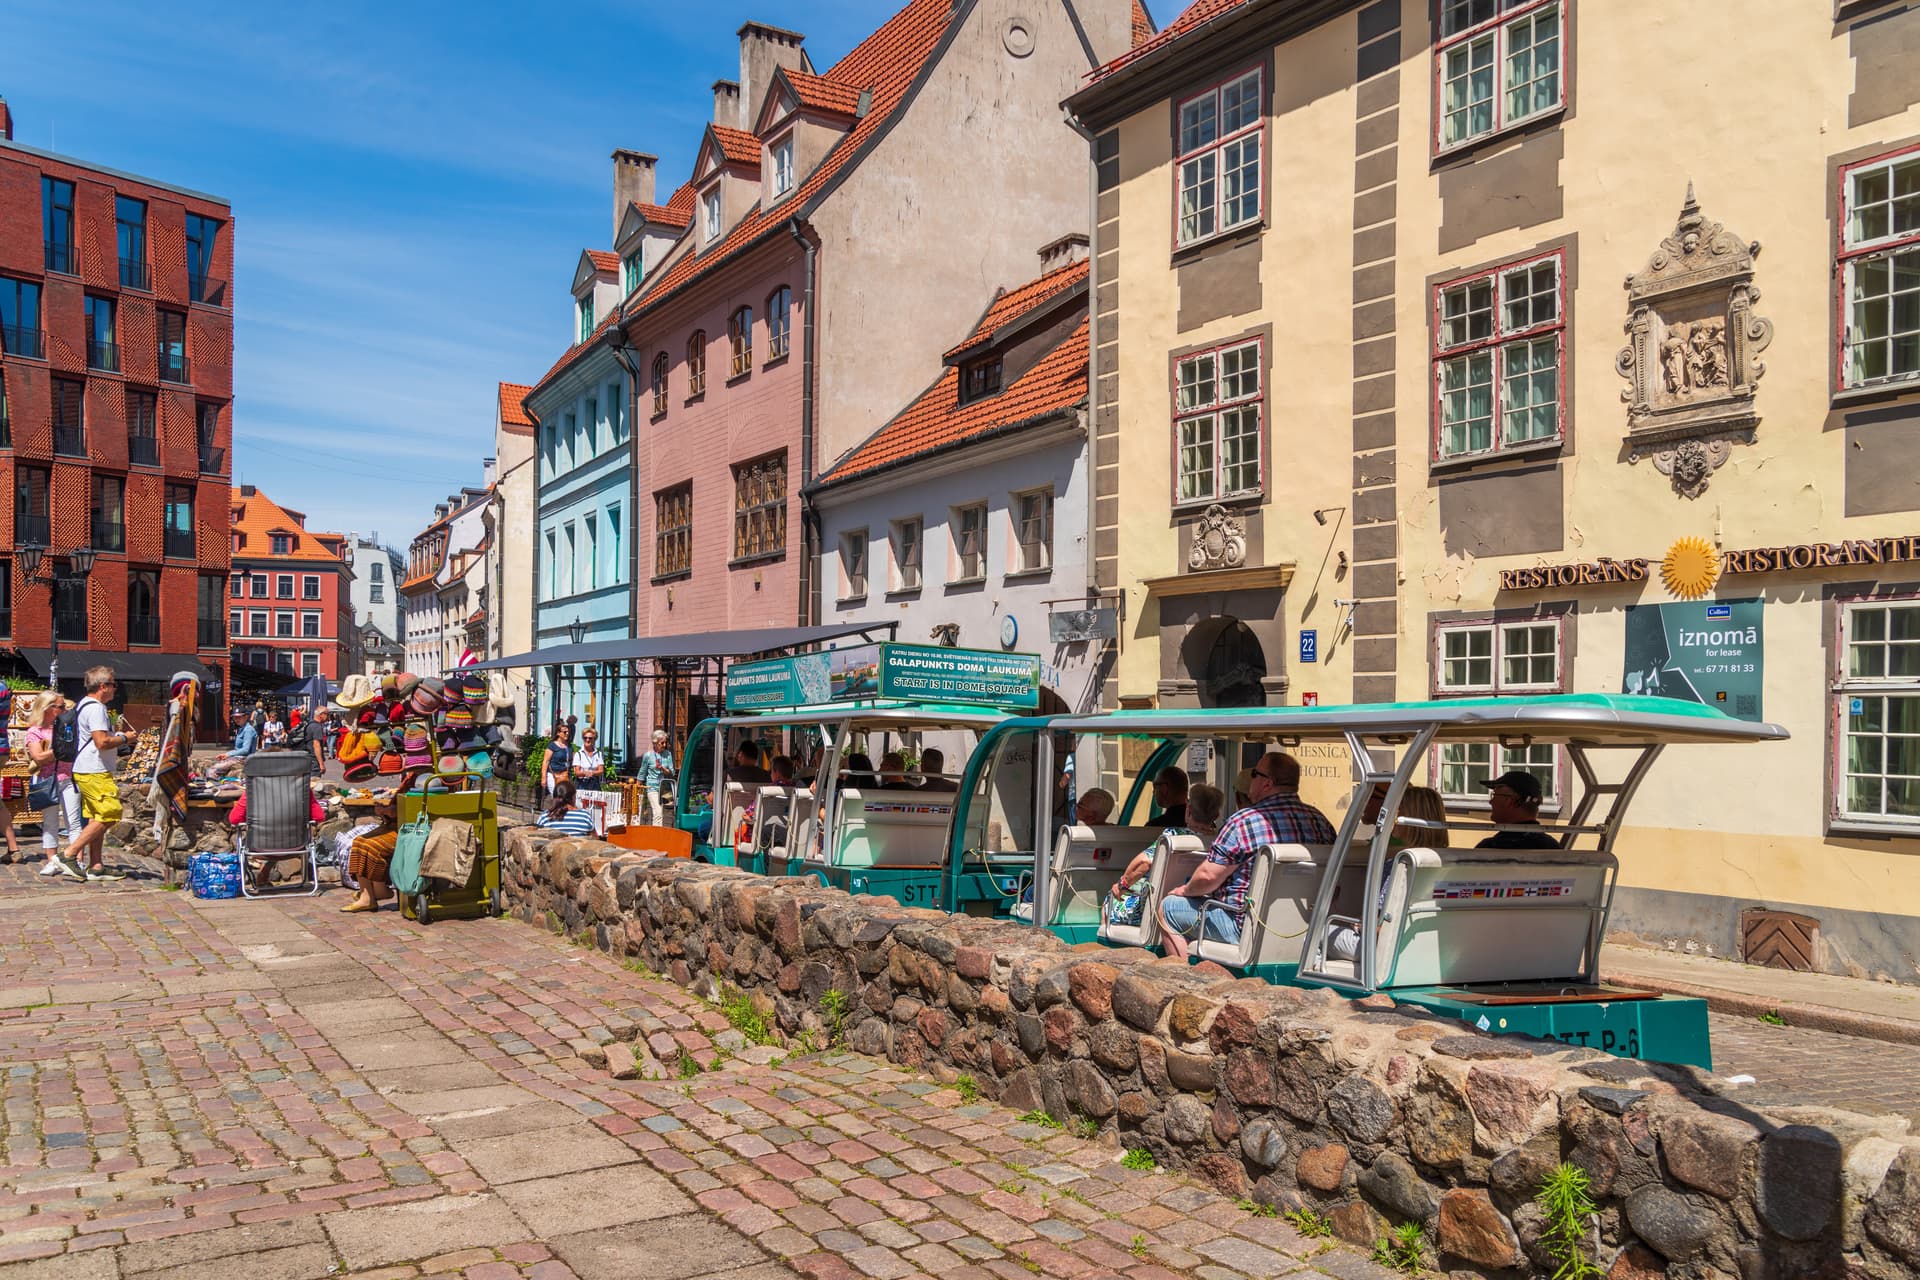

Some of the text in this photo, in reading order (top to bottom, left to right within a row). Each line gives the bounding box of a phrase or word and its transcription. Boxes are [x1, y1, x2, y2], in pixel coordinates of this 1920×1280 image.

[1724, 536, 1920, 574] RISTORANTE
[1499, 557, 1648, 591] RESTORĀNS
[1679, 626, 1757, 647] iznomā
[1302, 638, 1314, 652] 22
[1705, 648, 1742, 657] for lease
[889, 657, 955, 670] GALAPUNKTS
[957, 663, 985, 673] DOMA
[1705, 664, 1717, 673] 67
[1718, 664, 1728, 673] 71
[1730, 664, 1741, 673] 81
[1743, 664, 1754, 673] 33
[893, 677, 928, 689] START
[929, 680, 940, 690] IS
[942, 680, 954, 691] IN
[956, 682, 985, 693] DOME
[987, 684, 1028, 696] SQUARE
[1291, 743, 1348, 759] VIESNĪCA
[1300, 765, 1341, 778] HOTEL
[904, 884, 938, 902] STT
